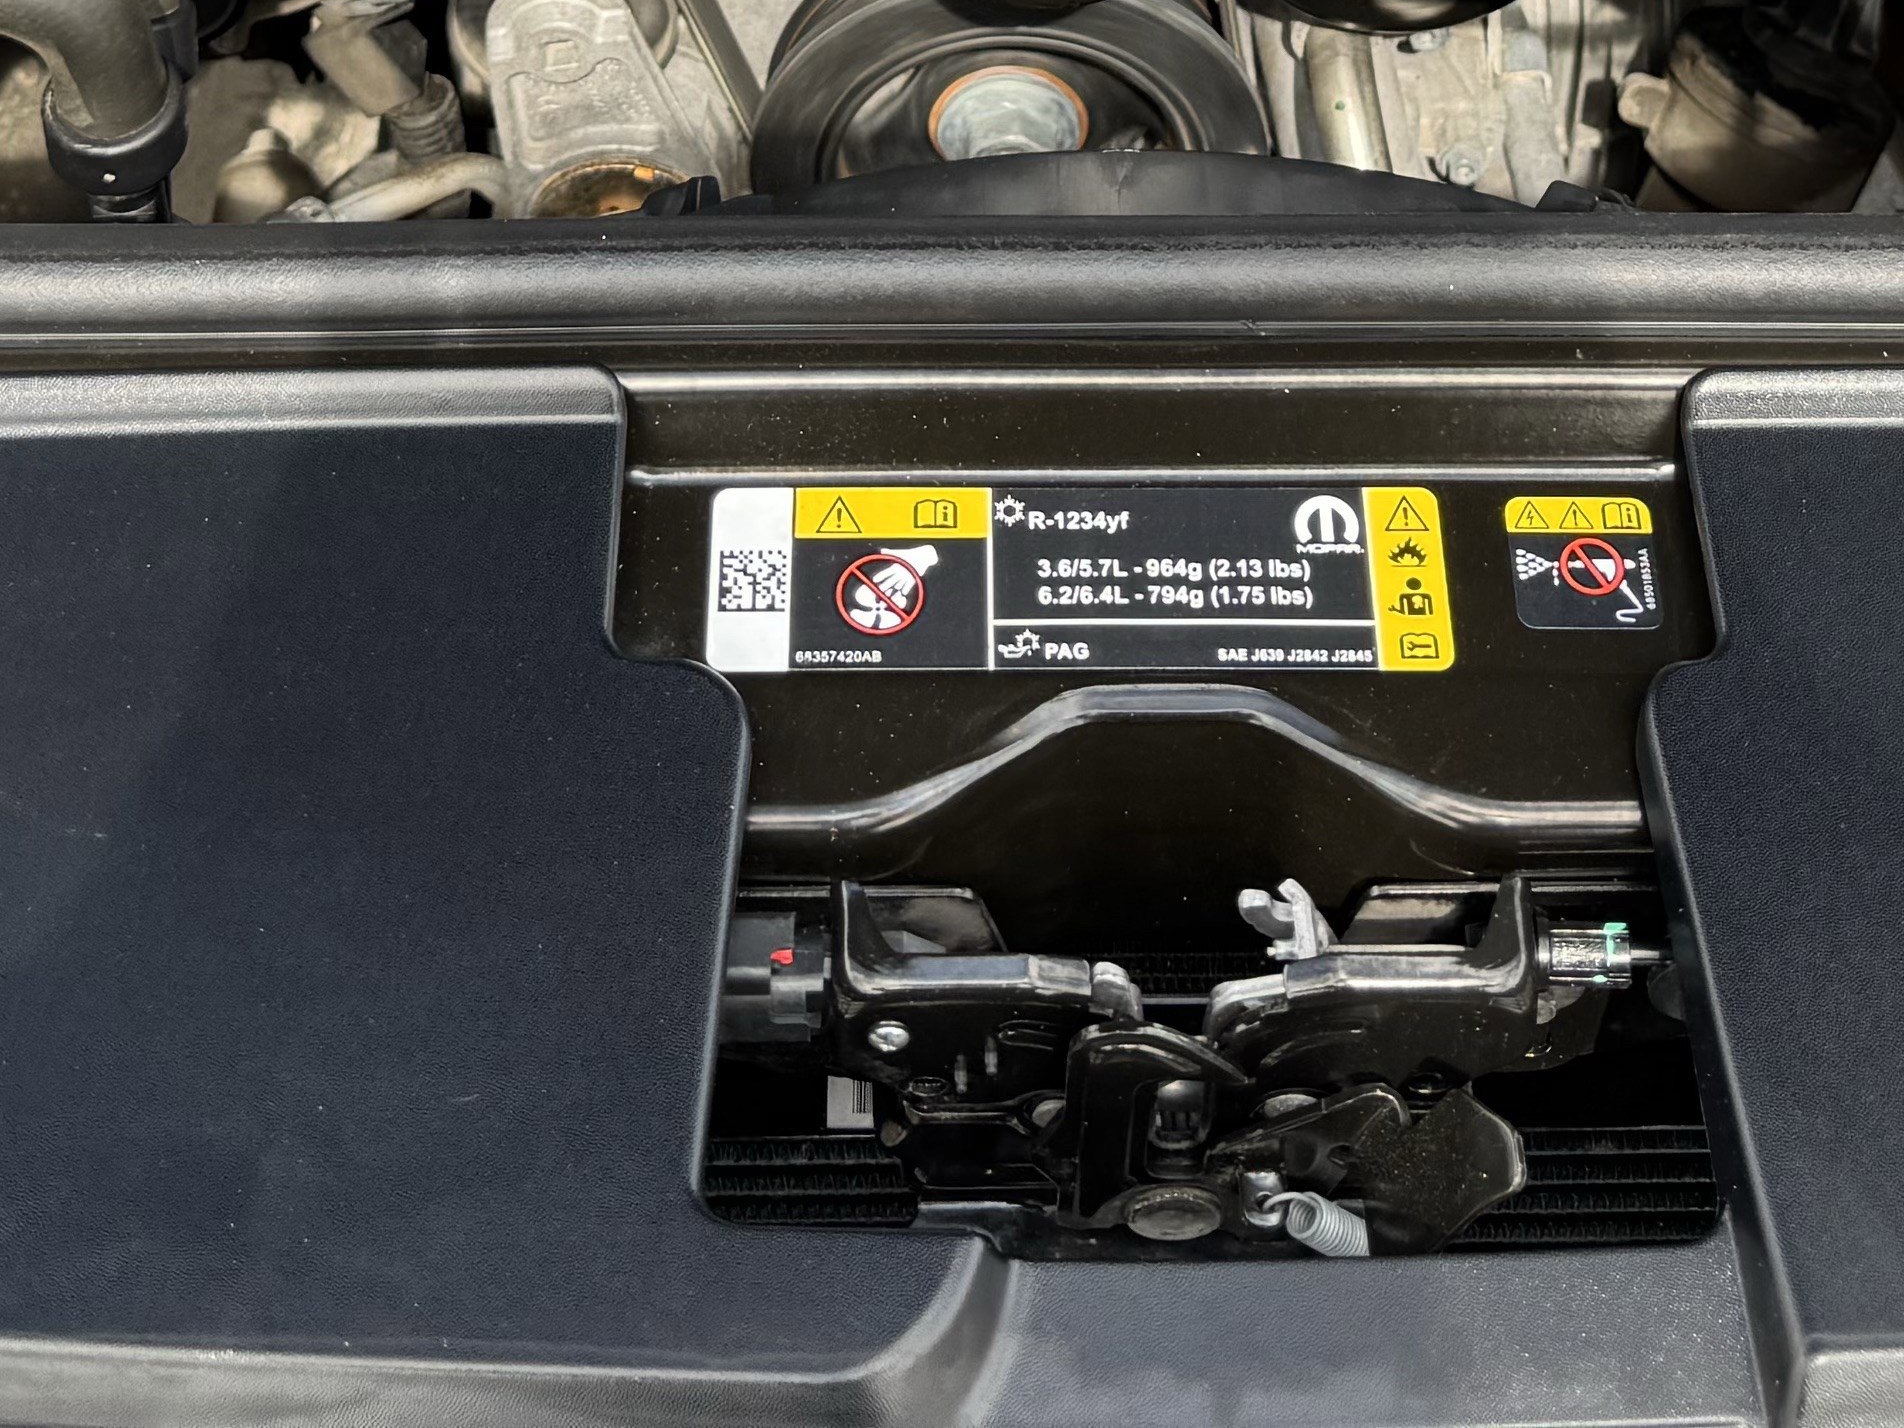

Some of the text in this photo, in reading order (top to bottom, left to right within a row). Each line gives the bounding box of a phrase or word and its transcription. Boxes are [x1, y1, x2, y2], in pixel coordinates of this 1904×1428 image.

[1028, 511, 1129, 533] R-1234yf
[1037, 559, 1128, 578] 3.6/5.7L
[1146, 559, 1202, 581] 964g
[1209, 559, 1262, 581] (2.13
[1269, 559, 1311, 582] lbs)
[1037, 586, 1129, 605] 6.2/6.4L
[1147, 586, 1204, 608] 794g
[1210, 586, 1265, 608] (1.75
[1271, 586, 1313, 609] lbs)
[1044, 643, 1090, 660] PAG
[1217, 648, 1248, 662] SAE
[1251, 648, 1284, 662] J639
